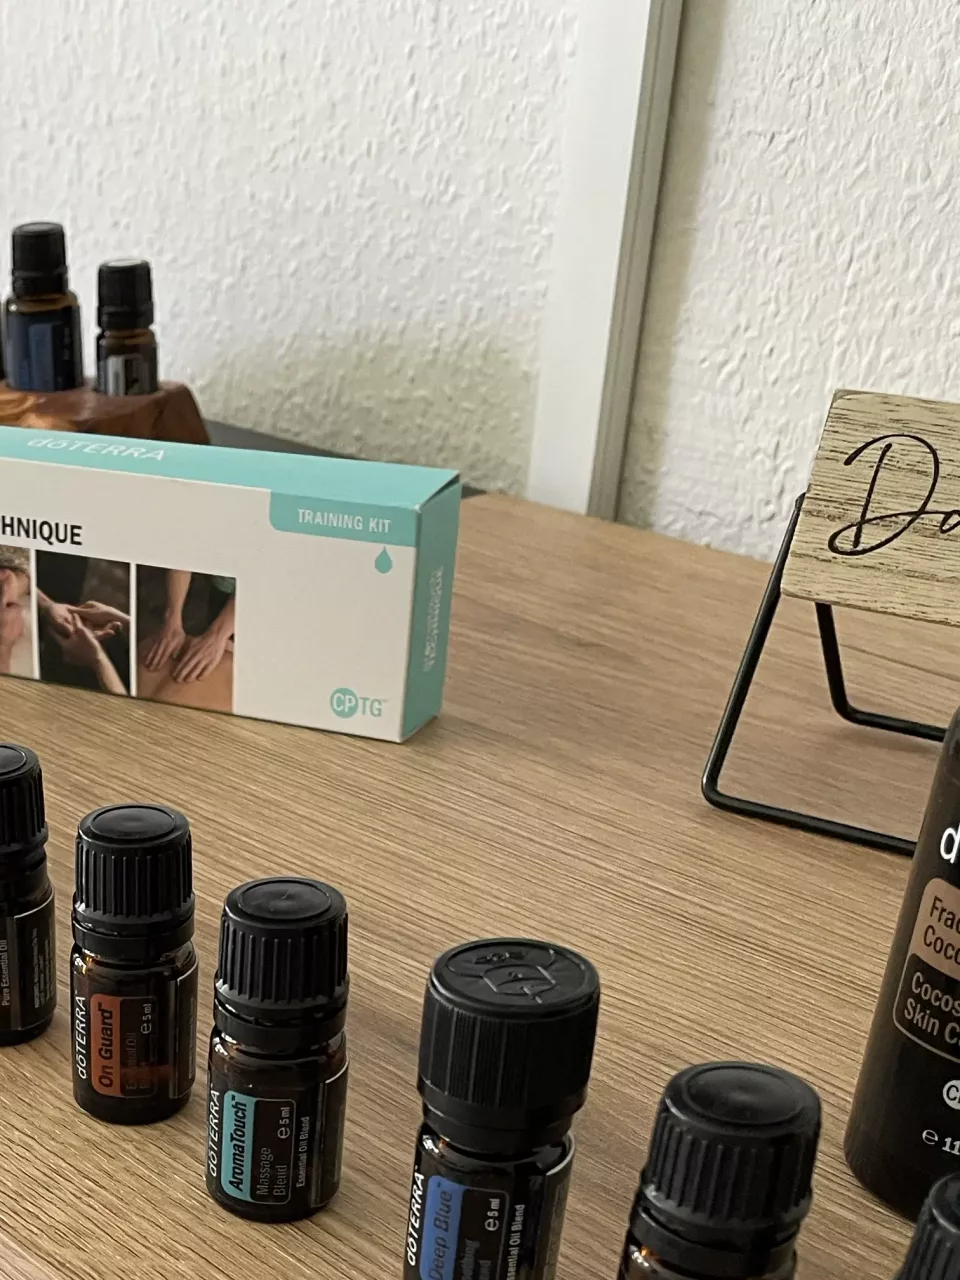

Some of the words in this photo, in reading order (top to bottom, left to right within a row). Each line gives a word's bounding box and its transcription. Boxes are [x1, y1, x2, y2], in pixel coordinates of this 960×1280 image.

[297, 508, 363, 530] TRAINING
[368, 517, 392, 534] KIT
[330, 689, 383, 718] CPTG
[0, 952, 10, 987] Essential
[1, 988, 11, 1006] Pure
[142, 1003, 152, 1014] ml
[904, 997, 940, 1037] Skin
[944, 1022, 960, 1048] C
[98, 1066, 113, 1088] On
[280, 1107, 291, 1117] ml
[299, 1116, 310, 1140] Blend
[298, 1141, 308, 1152] Oil
[256, 1147, 274, 1196] Massage
[273, 1164, 288, 1197] Blend
[296, 1153, 308, 1188] Essential
[433, 1190, 453, 1233] Blue
[488, 1198, 501, 1209] ml
[511, 1203, 526, 1231] Blend
[508, 1232, 522, 1246] Oil
